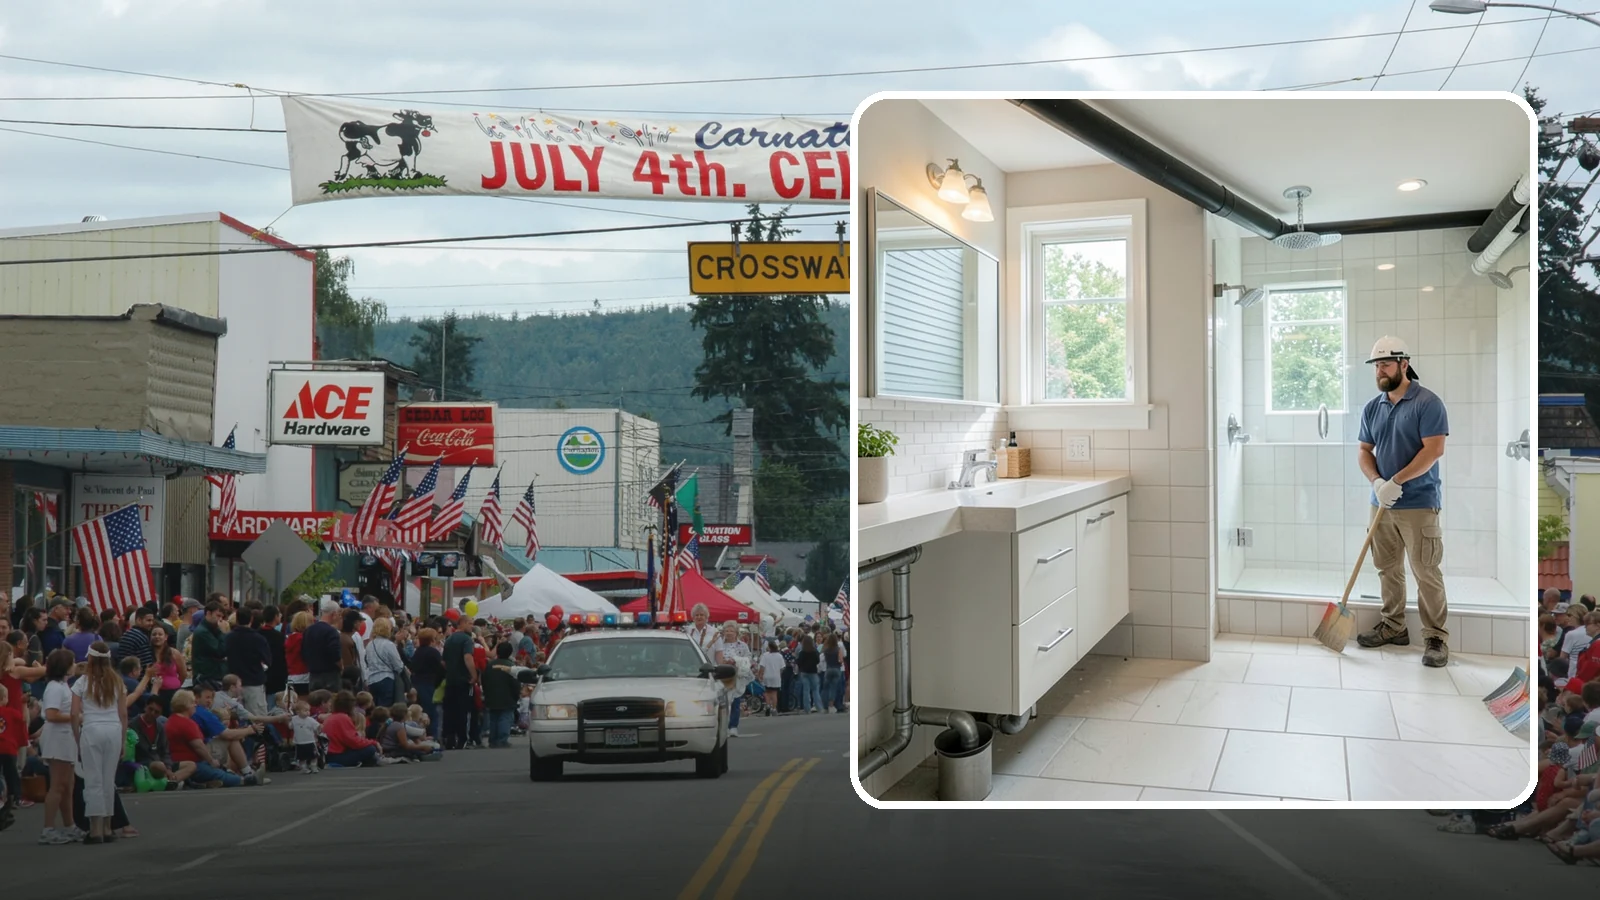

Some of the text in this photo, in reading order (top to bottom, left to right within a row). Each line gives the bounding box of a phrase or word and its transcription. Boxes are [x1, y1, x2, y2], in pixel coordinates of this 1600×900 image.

[481, 140, 605, 193] JULY
[632, 149, 746, 198] 4th.
[697, 254, 850, 280] CROSSWA
[282, 380, 373, 419] ACE
[406, 409, 453, 422] CEDAR
[283, 421, 370, 437] Hardware
[416, 428, 477, 447] Coca-Cola
[96, 486, 124, 494] Vincent
[126, 486, 135, 494] de
[137, 486, 155, 495] Paul
[688, 526, 741, 535] CRNATION
[699, 535, 730, 543] GLASS
